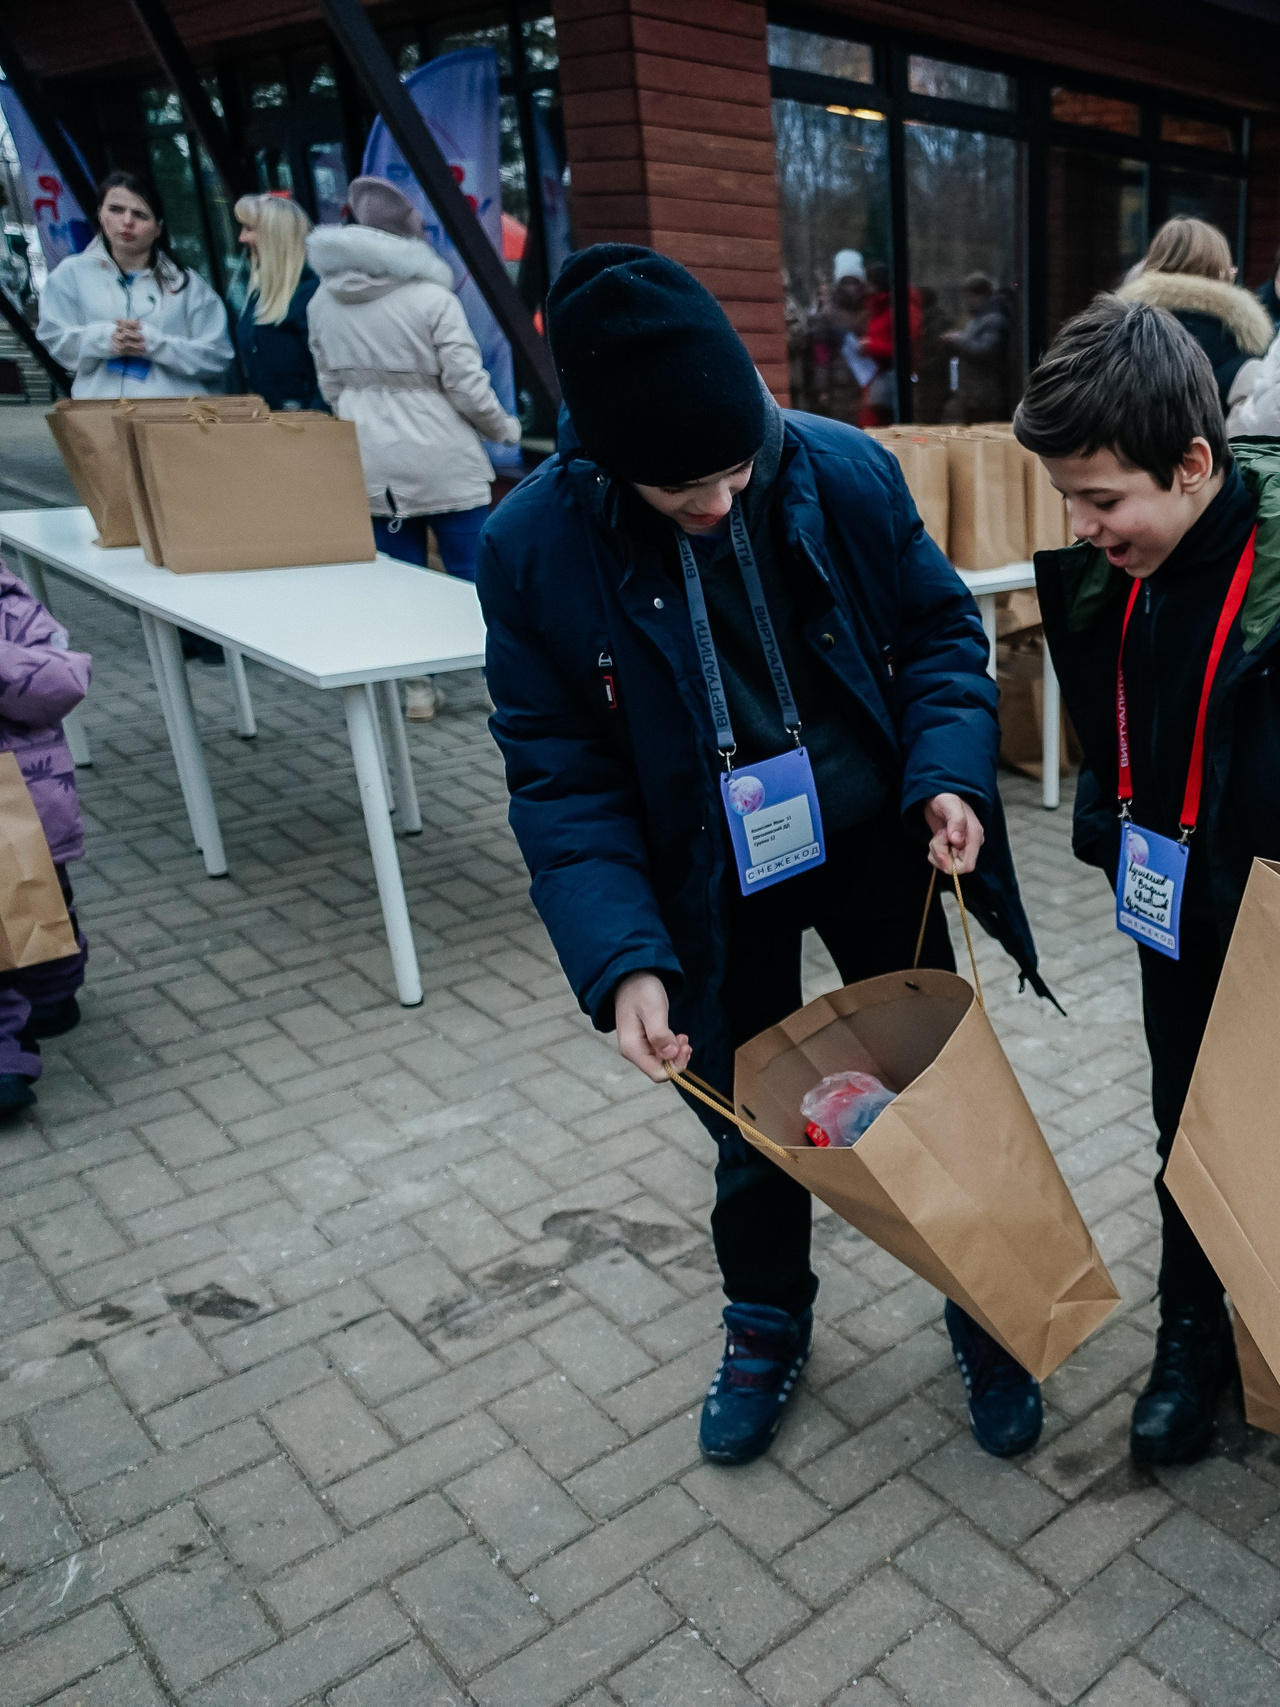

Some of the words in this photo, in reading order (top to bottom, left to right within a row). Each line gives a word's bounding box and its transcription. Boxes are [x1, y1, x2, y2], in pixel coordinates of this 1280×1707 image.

[694, 618, 729, 728] ВИРТУАЛИТИ
[753, 605, 793, 707] ВИРТУАЛИТИ
[747, 846, 820, 880] СНЕЖЕКОД
